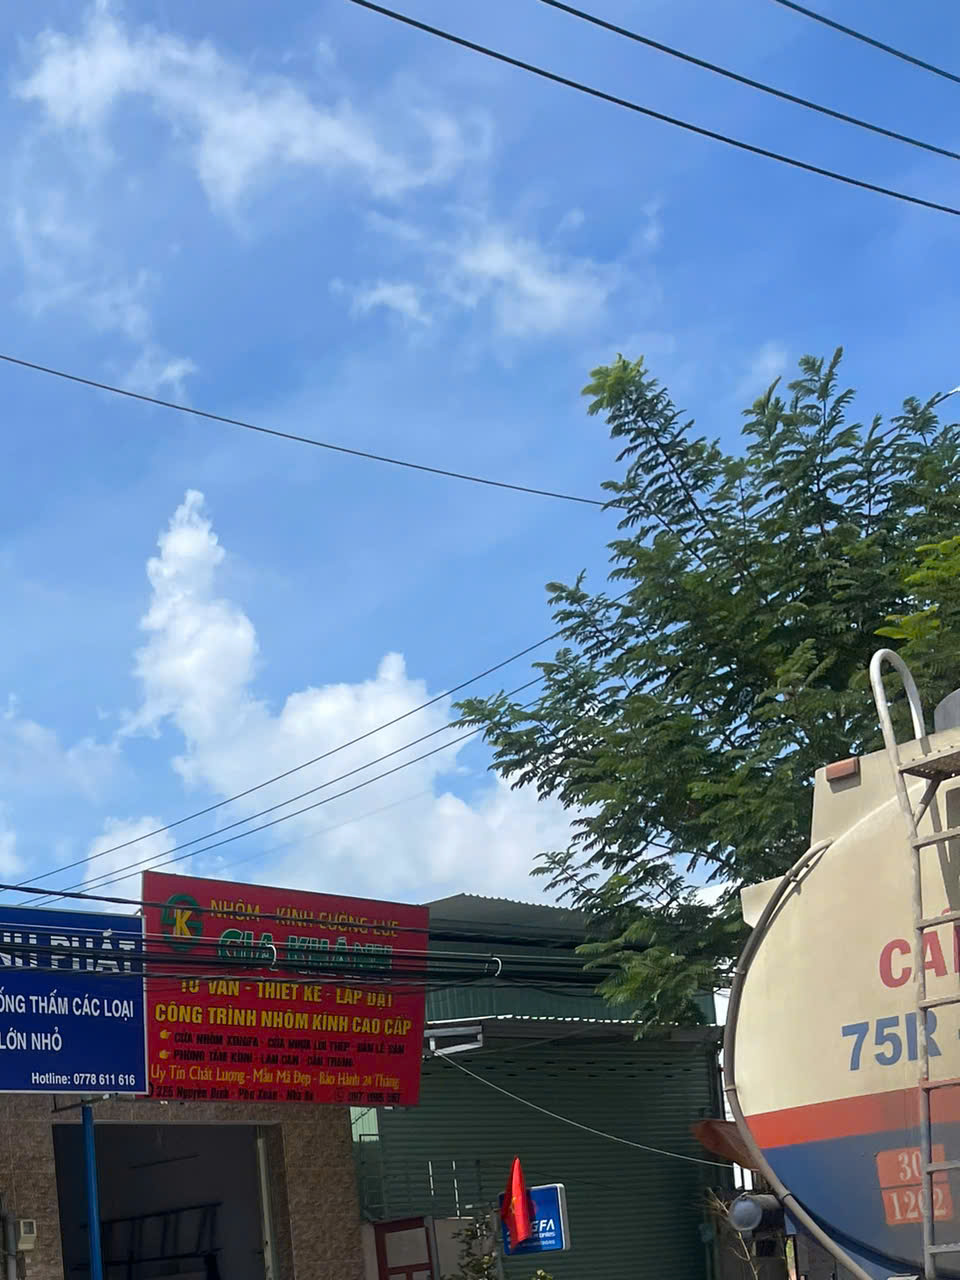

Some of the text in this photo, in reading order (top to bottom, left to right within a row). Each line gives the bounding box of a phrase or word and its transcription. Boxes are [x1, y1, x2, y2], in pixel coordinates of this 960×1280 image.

[29, 989, 68, 1016] THẤM
[72, 994, 100, 1017] CÁC
[104, 1000, 133, 1021] LOẠI
[155, 1000, 202, 1023] CÔNG
[208, 1005, 256, 1026] TRÌNH
[261, 1009, 308, 1030] NHÔM
[312, 1012, 348, 1032] KÍNH
[352, 1016, 380, 1034] CAO
[31, 1027, 62, 1051] NHỎ
[31, 1072, 135, 1086] Hotline: 0778 611 616
